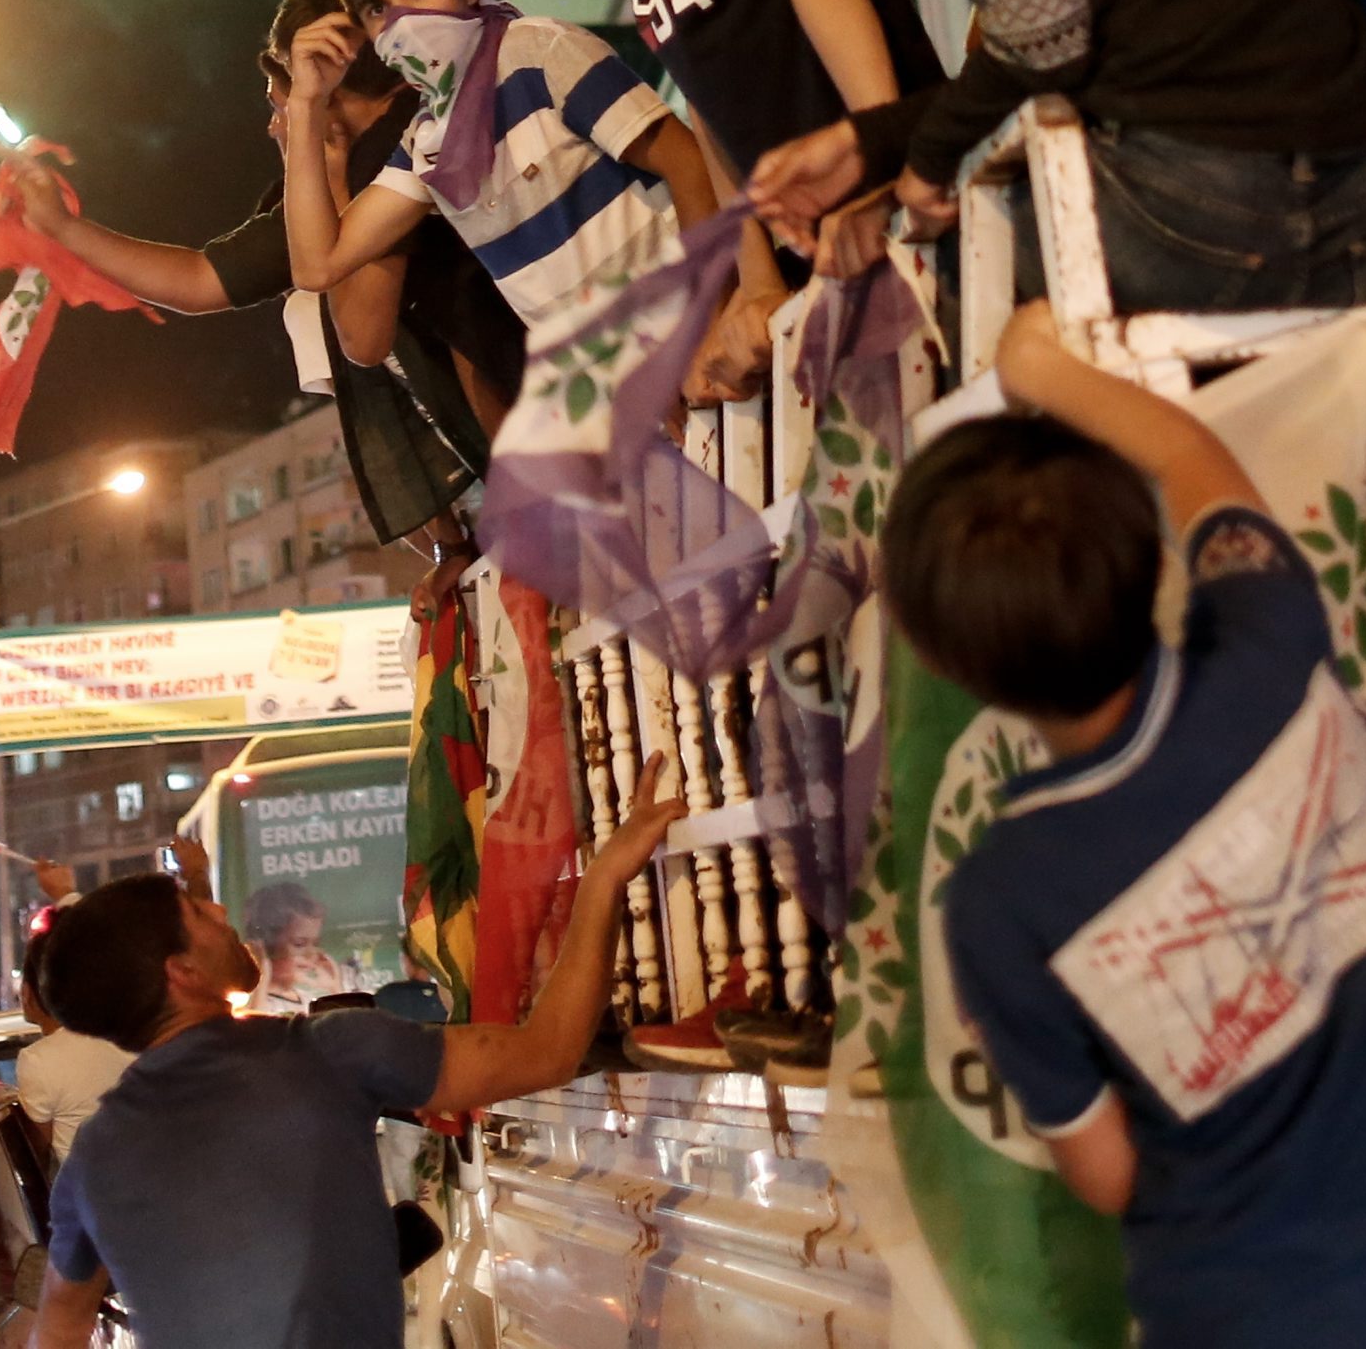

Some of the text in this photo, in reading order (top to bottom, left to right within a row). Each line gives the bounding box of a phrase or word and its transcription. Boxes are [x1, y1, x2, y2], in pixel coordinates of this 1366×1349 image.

[257, 788, 325, 821] DOĞA
[260, 812, 407, 848] ERKEN KAYIT
[262, 844, 362, 878] BAŞLADI
